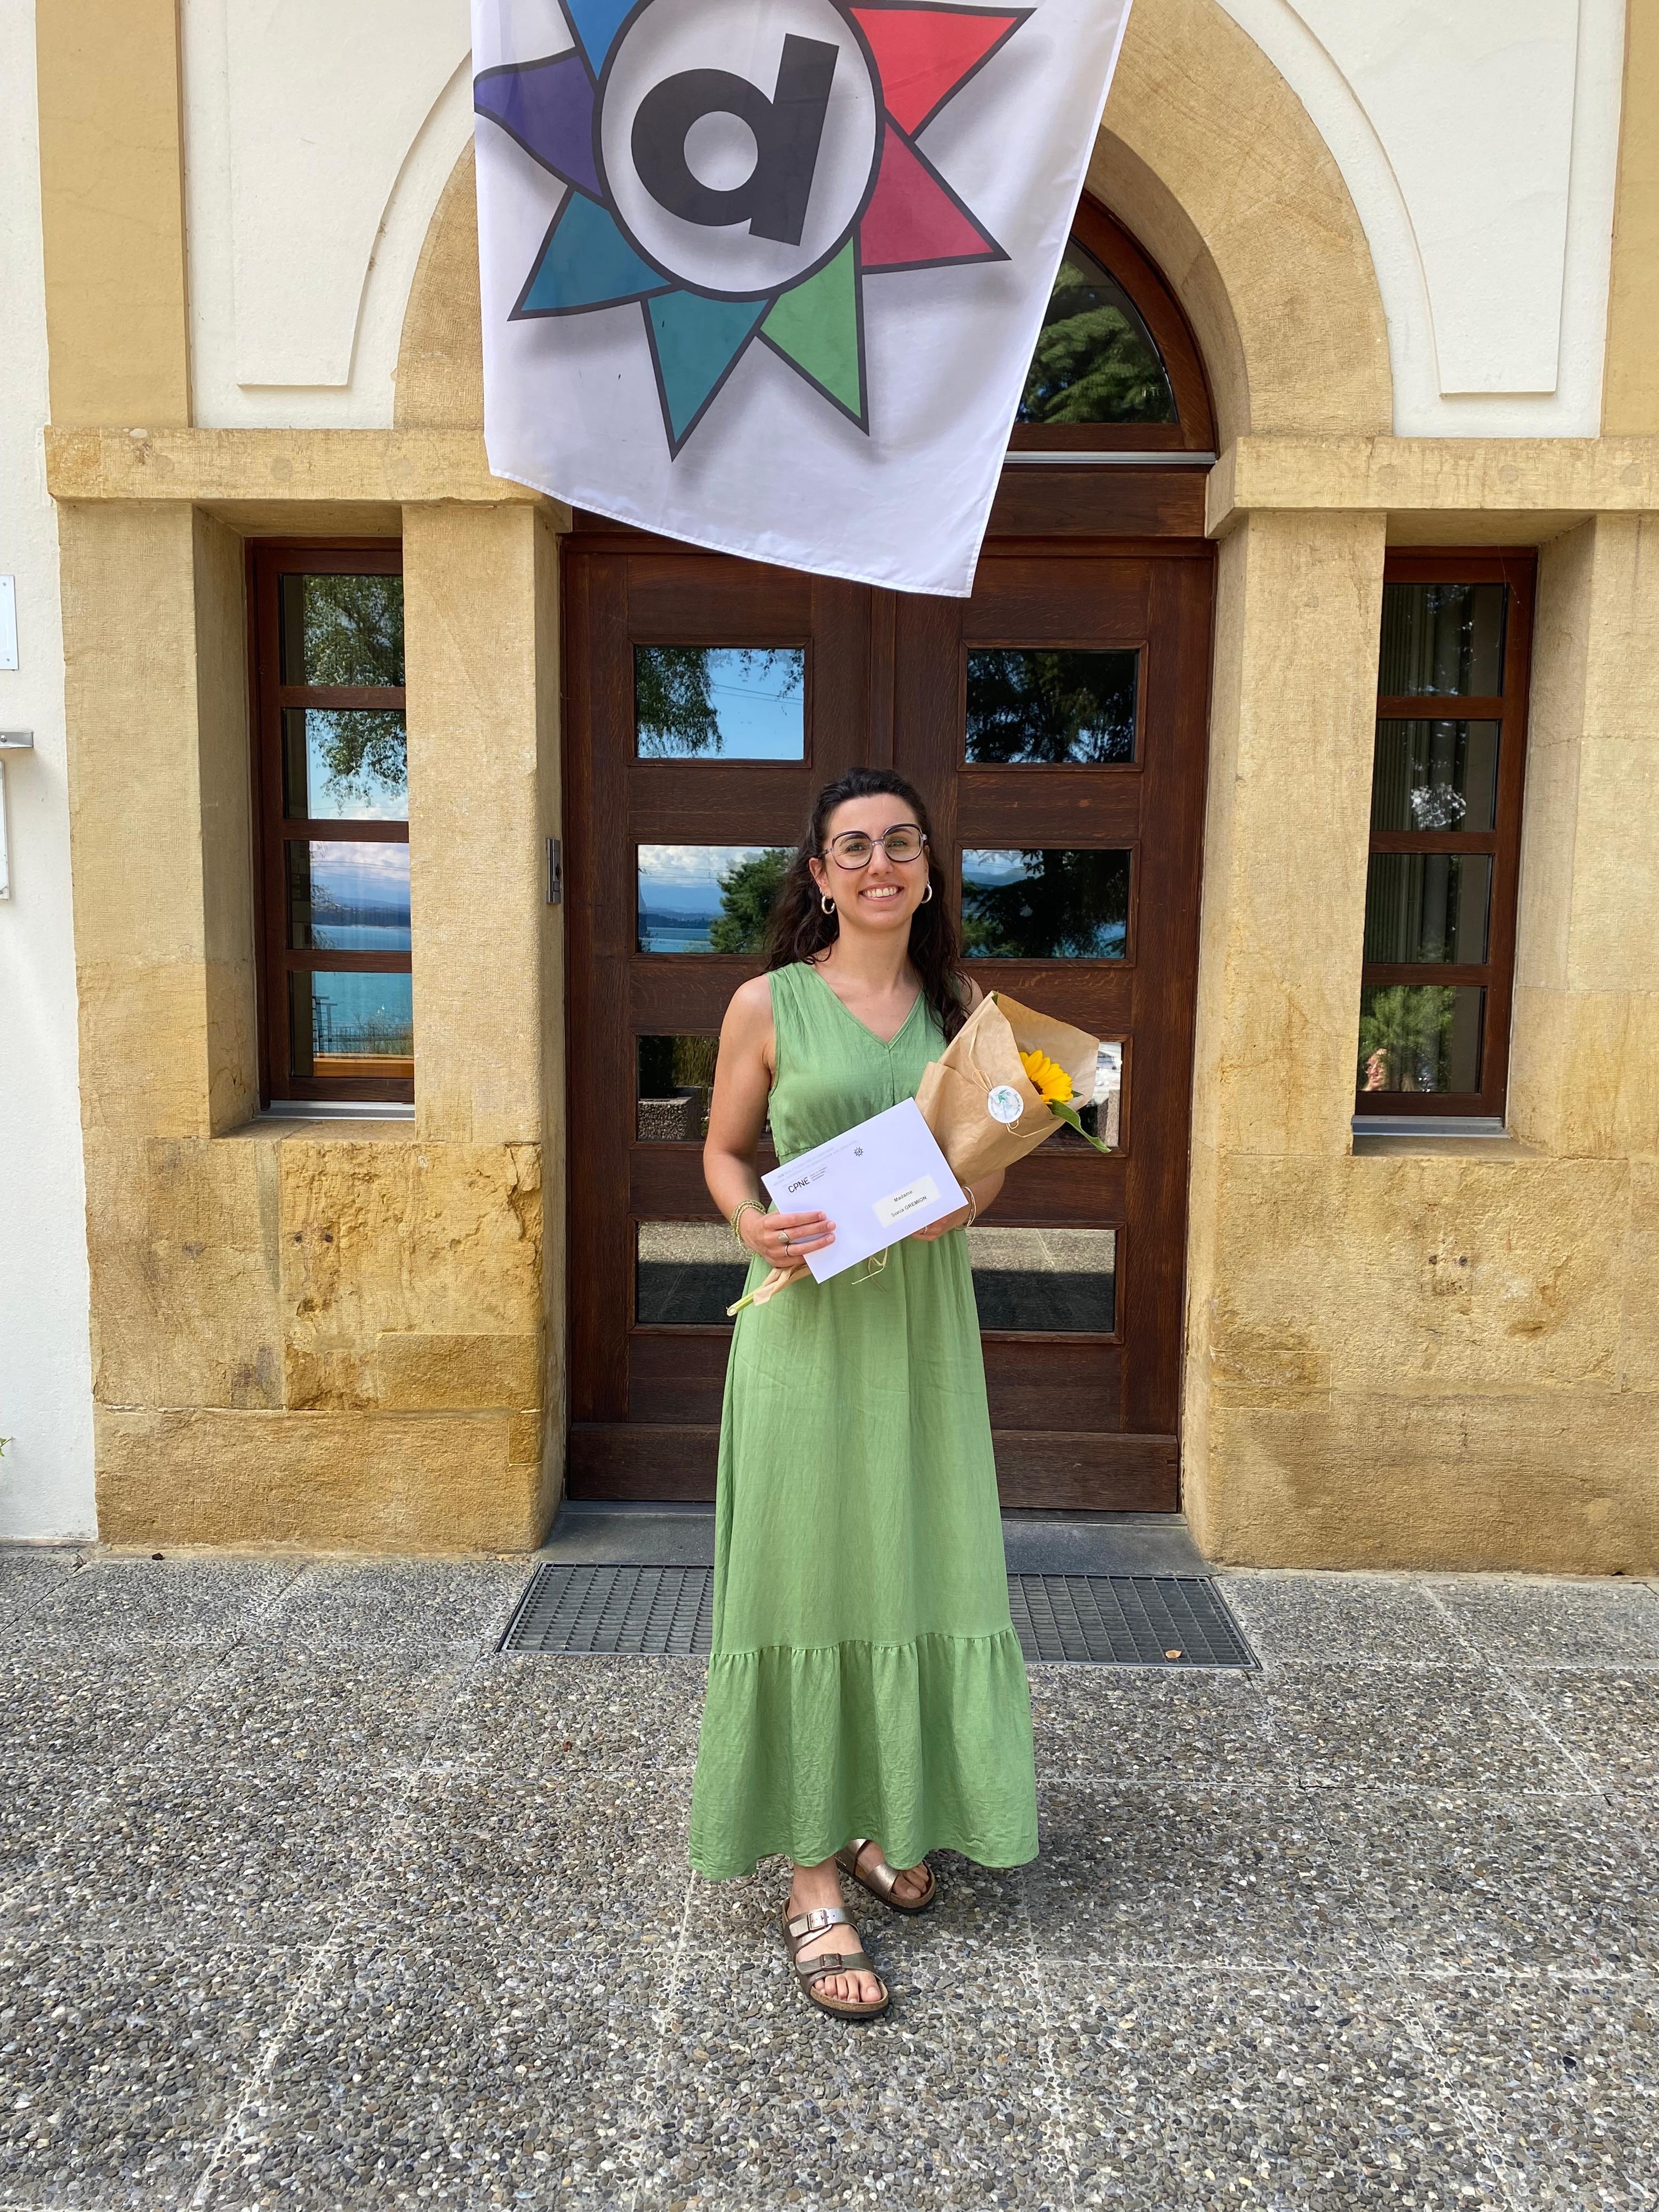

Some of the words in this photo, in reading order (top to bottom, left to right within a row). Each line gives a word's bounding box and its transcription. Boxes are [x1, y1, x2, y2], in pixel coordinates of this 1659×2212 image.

[631, 33, 839, 247] d
[788, 1177, 811, 1193] CPNE
[894, 1190, 913, 1202] Madame
[891, 1209, 905, 1217] Sonia
[905, 1195, 927, 1210] GREMION
